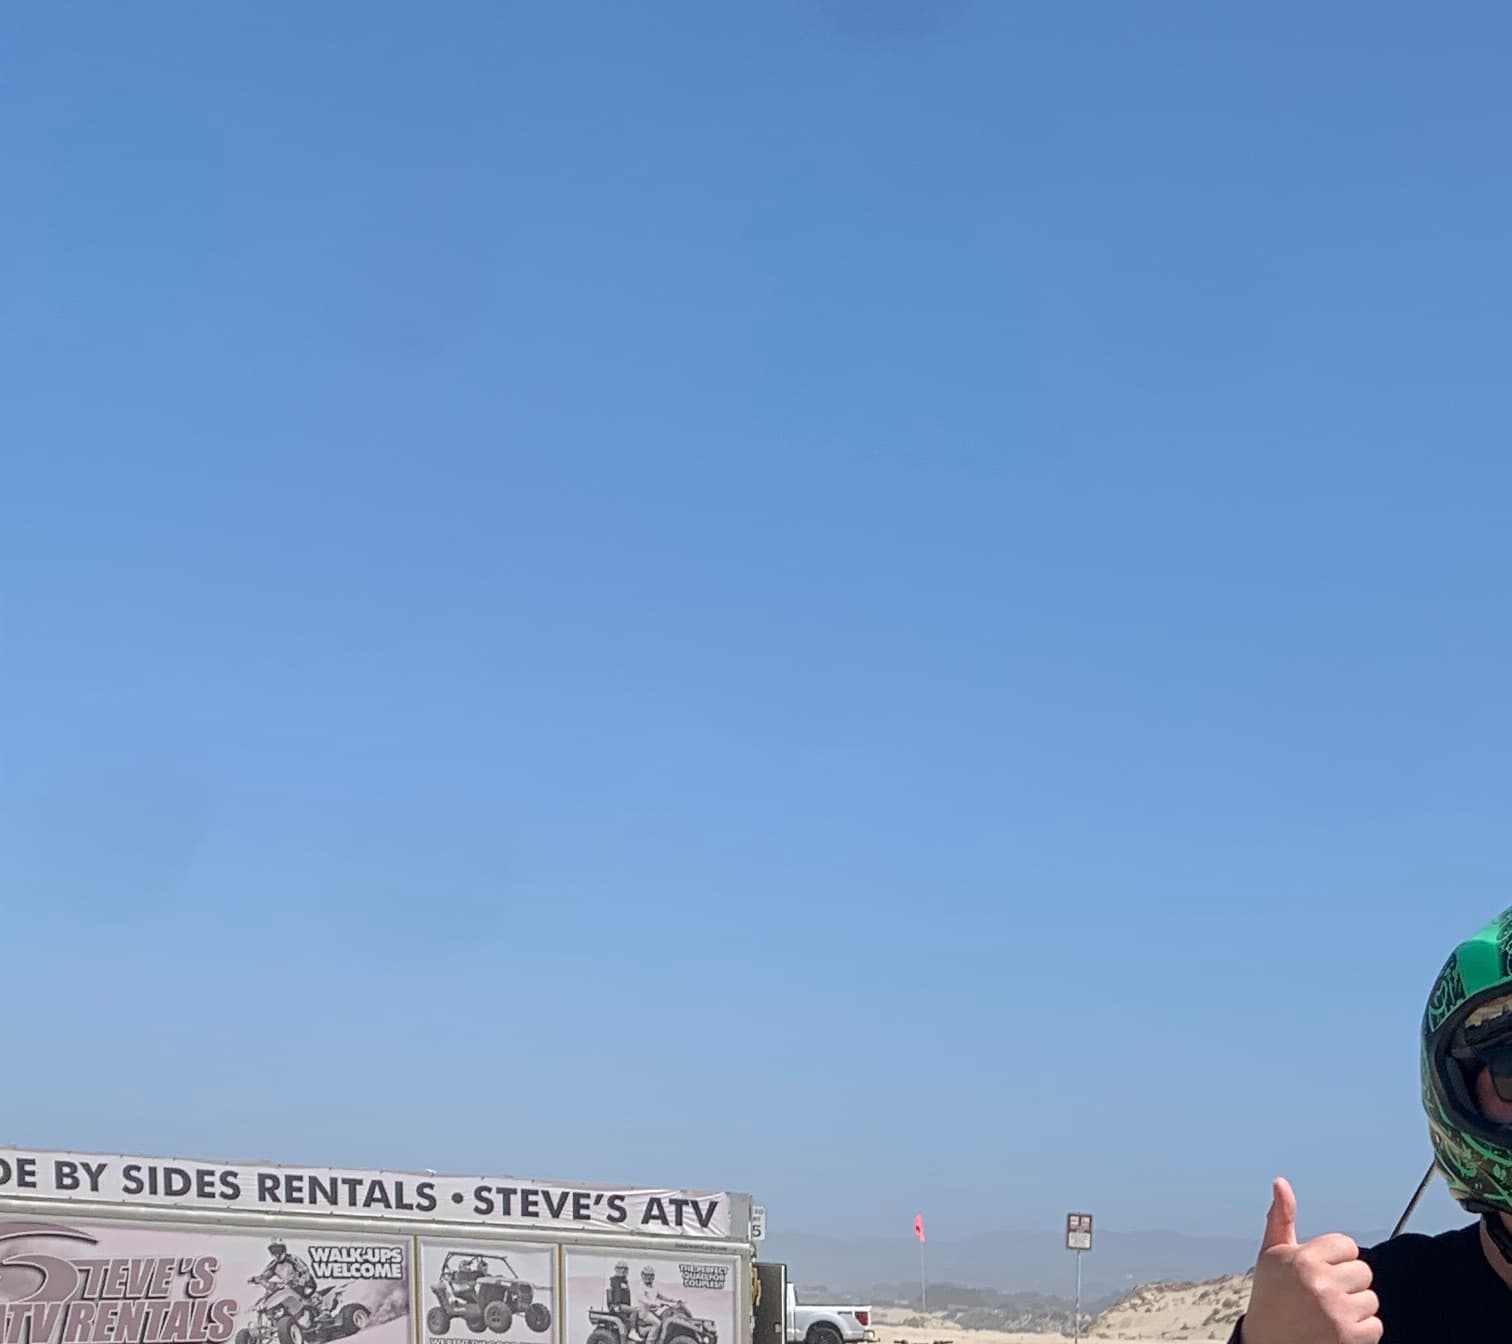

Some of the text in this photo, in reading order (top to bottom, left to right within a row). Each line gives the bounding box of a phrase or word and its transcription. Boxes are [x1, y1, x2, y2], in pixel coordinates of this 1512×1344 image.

[54, 1160, 108, 1192] BY
[122, 1164, 241, 1201] SIDES
[257, 1173, 437, 1212] RENTALS
[473, 1185, 627, 1223] STEVE'S
[641, 1197, 718, 1228] ATV
[308, 1246, 402, 1263] WALK-UPS
[312, 1262, 402, 1279] WELCOME
